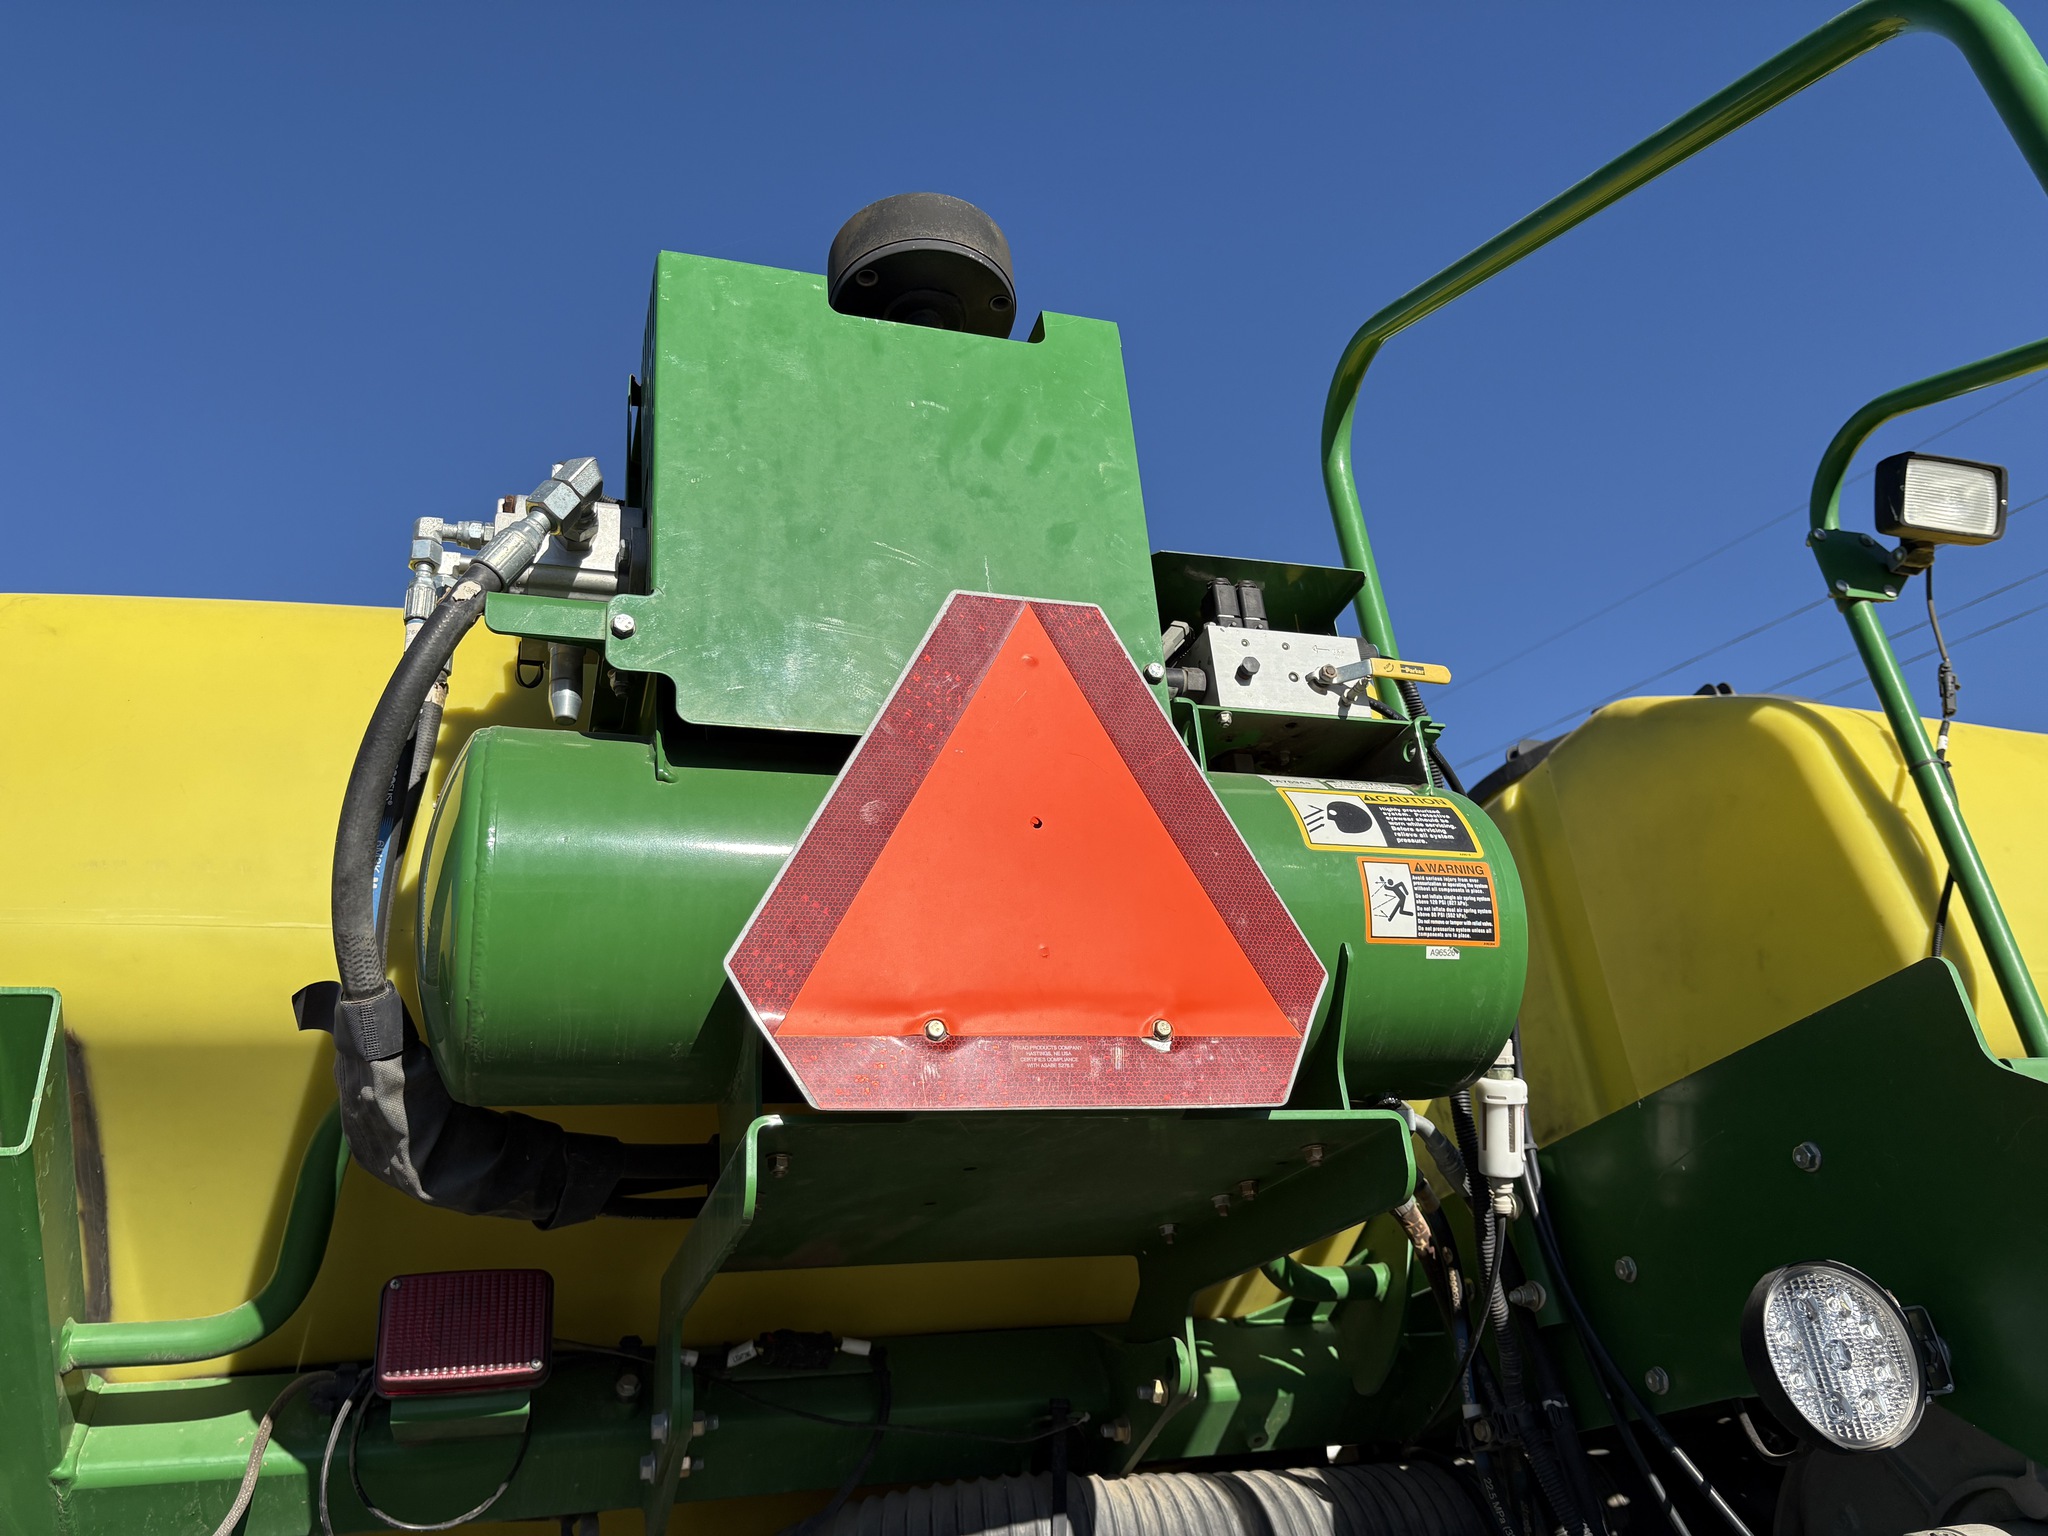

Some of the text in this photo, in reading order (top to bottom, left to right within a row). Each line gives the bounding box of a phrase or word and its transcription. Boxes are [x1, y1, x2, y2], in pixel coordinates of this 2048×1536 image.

[1404, 666, 1424, 675] Parker
[1376, 795, 1447, 805] CAUTION
[1425, 863, 1484, 875] WARNING
[1483, 1477, 1498, 1500] 22.5
[1492, 1501, 1507, 1525] MPa
